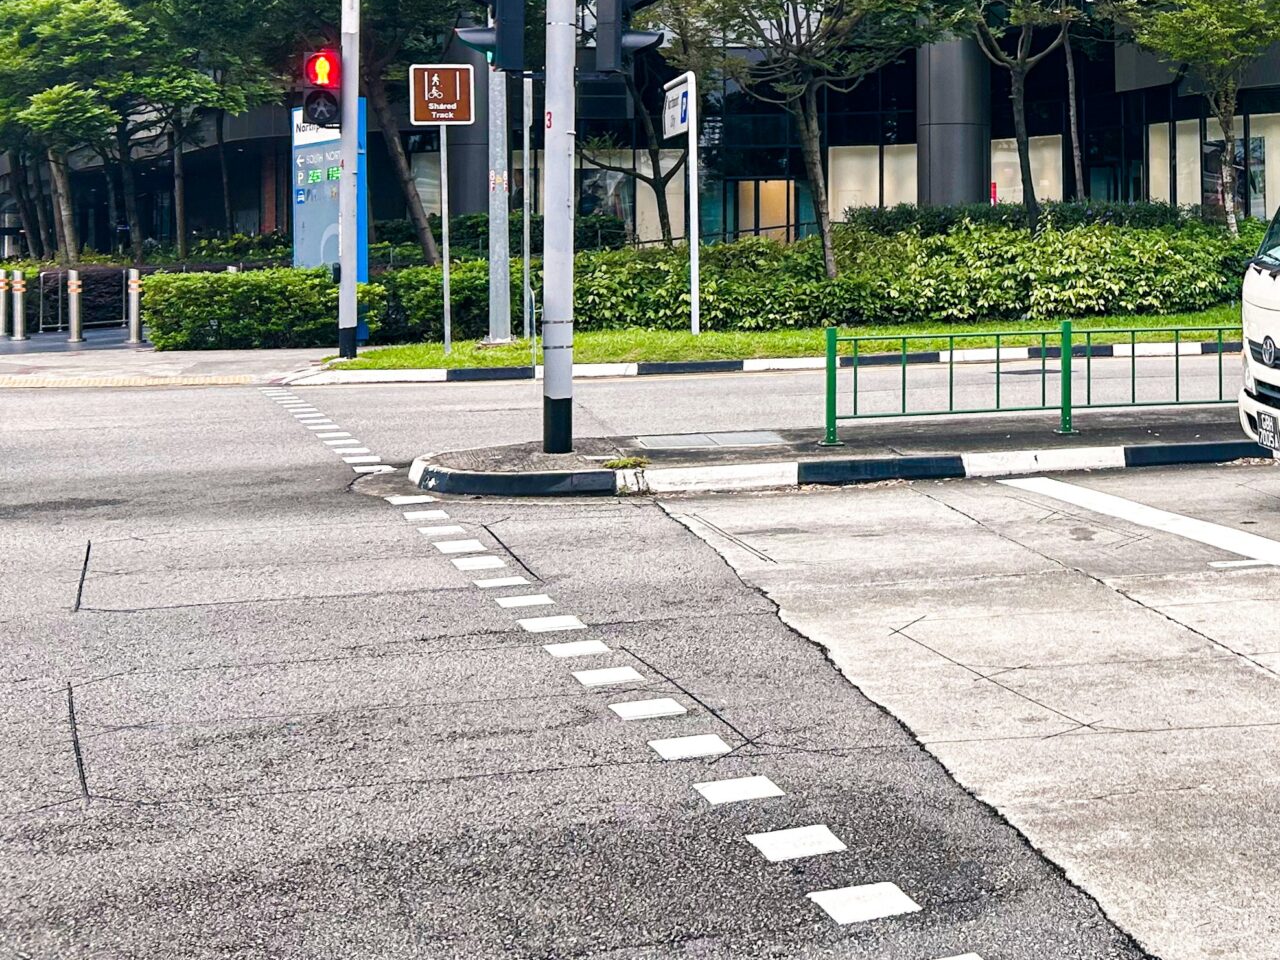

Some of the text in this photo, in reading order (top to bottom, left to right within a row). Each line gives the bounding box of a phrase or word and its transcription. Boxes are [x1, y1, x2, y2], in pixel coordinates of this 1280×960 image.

[428, 102, 457, 110] Shared
[431, 111, 455, 119] Track
[546, 111, 552, 129] 3
[325, 150, 342, 161] NORT
